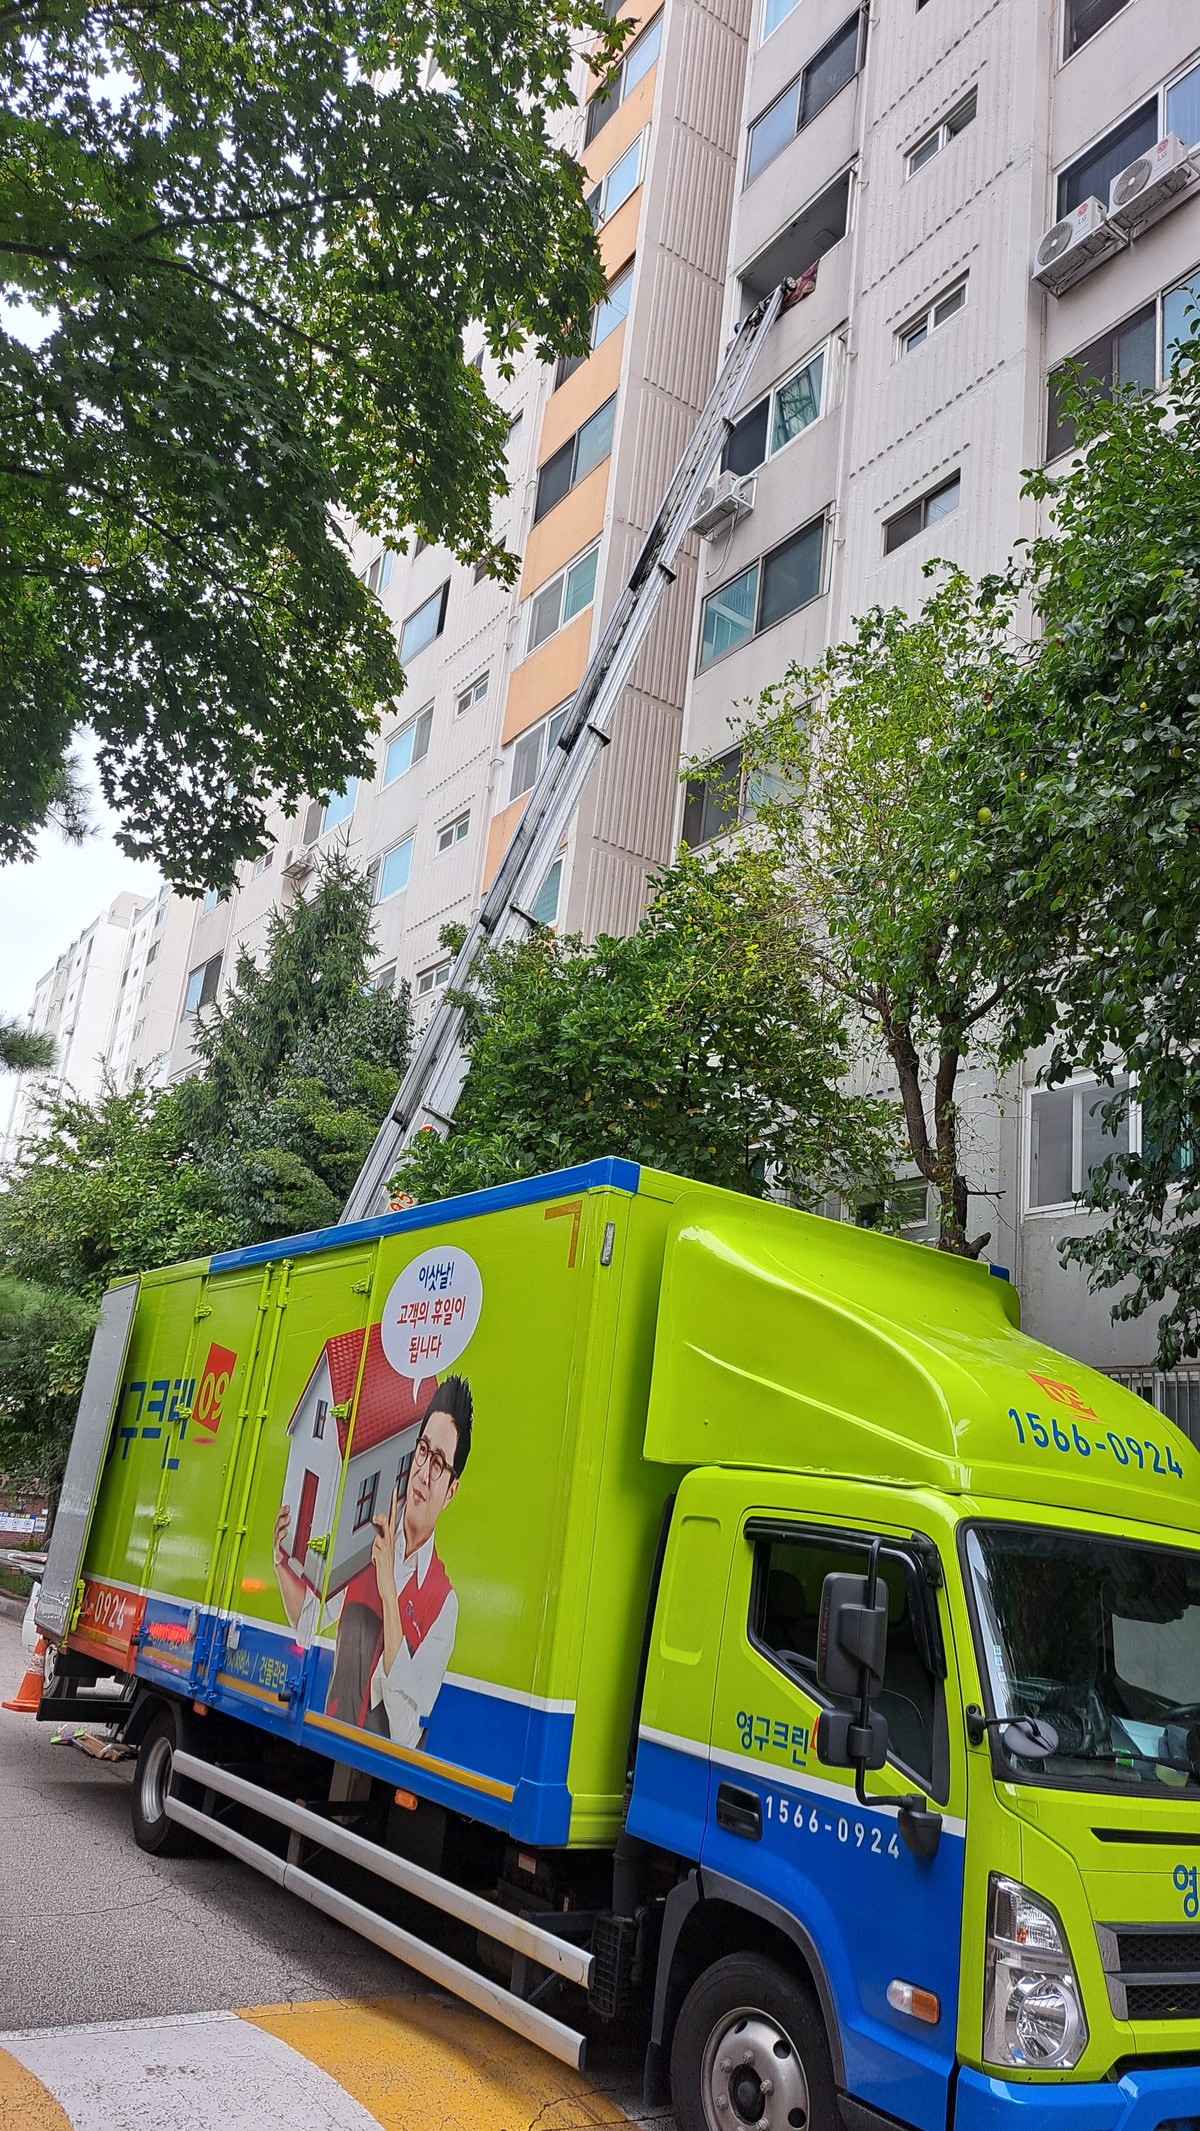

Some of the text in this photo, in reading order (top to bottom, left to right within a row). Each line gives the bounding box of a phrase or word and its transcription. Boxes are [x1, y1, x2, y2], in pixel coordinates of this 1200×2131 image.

[418, 1261, 455, 1291] 이삿날!
[396, 1296, 467, 1329] 고객의 휴일이
[408, 1334, 442, 1364] 됩니다
[107, 1371, 230, 1470] 구크린 09
[1007, 1407, 1184, 1480] 1566-0924
[258, 1656, 288, 1692] 건물관리
[735, 1710, 810, 1768] 영구크린
[766, 1795, 900, 1860] 1566-0924
